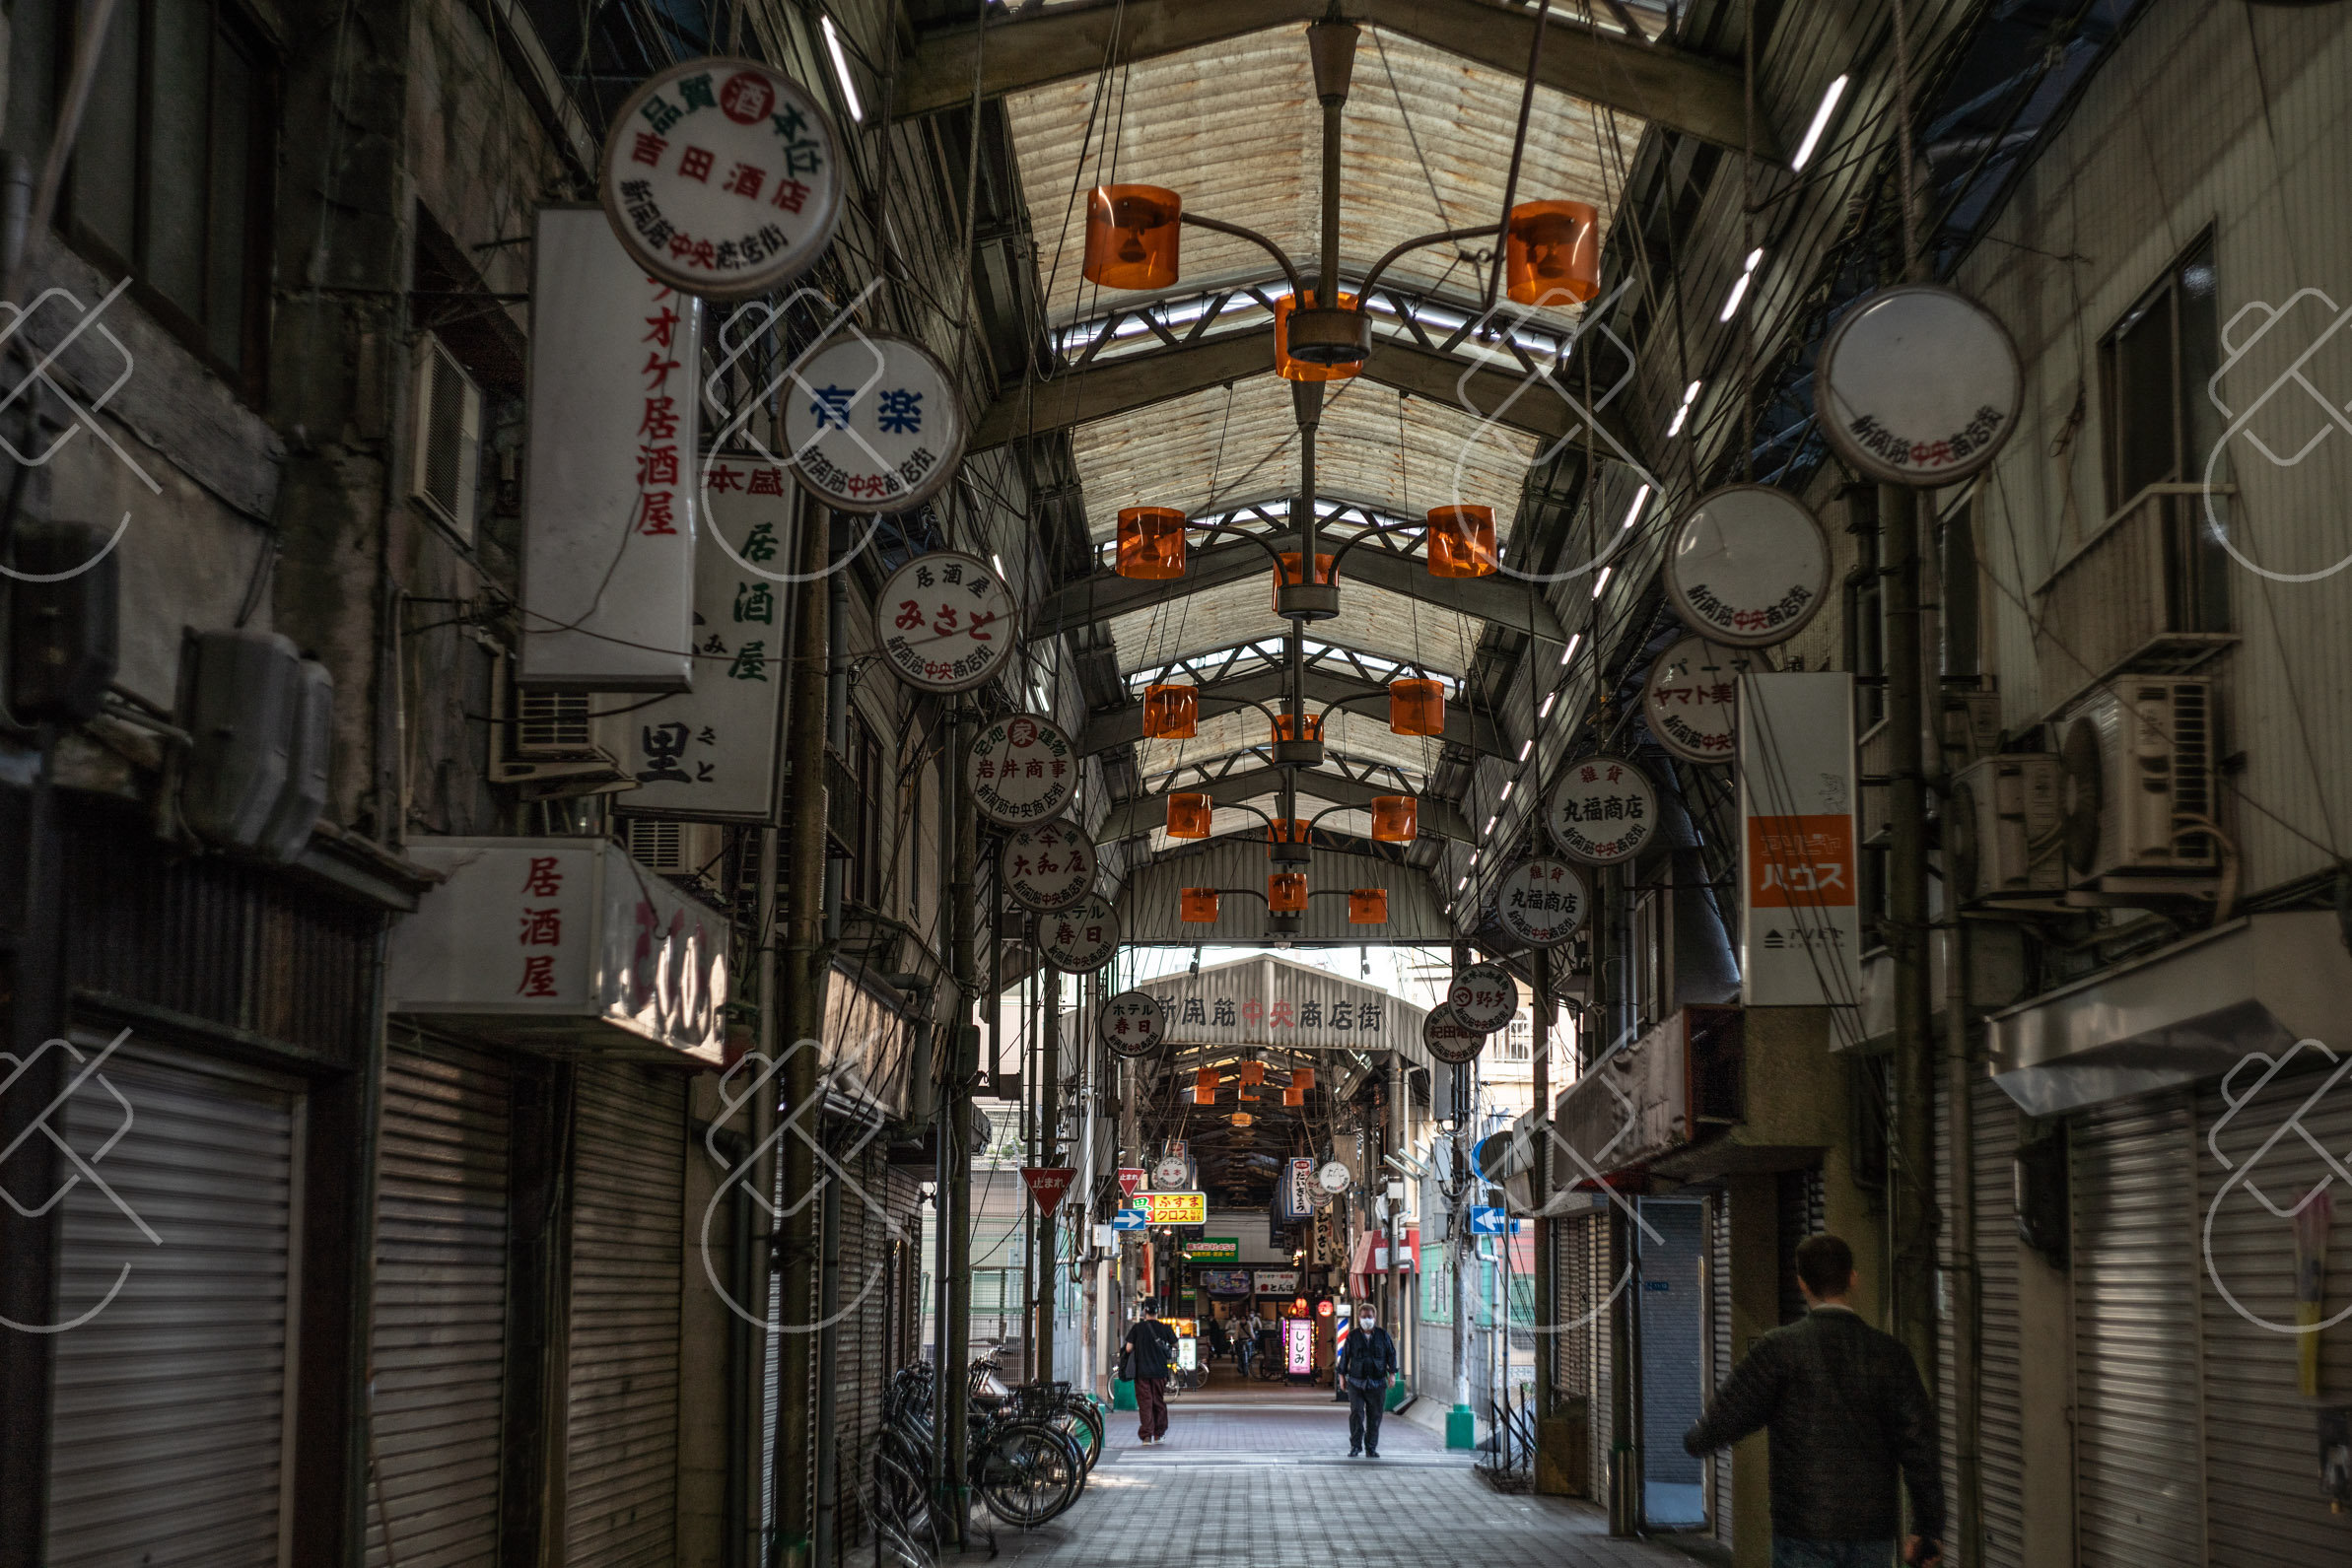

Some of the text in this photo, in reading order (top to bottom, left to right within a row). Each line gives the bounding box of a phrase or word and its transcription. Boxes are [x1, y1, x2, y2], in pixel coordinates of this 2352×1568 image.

[723, 73, 773, 122] 酒
[632, 131, 811, 215] 吉田酒店
[809, 383, 923, 434] 有楽
[916, 562, 991, 599] 居酒屋
[727, 521, 779, 683] 居酒屋
[895, 599, 996, 641] みさと
[976, 758, 1068, 779] 岩井商事
[1563, 793, 1645, 823] 丸福商店
[1760, 862, 1845, 891] ハウス
[1510, 887, 1577, 915] 丸福商店
[516, 855, 565, 998] 居酒屋
[1113, 1003, 1153, 1016] ホテル
[1114, 1016, 1151, 1035] 春日
[1032, 1177, 1066, 1189] 止まれ
[1157, 1209, 1189, 1220] クロス
[1159, 1196, 1199, 1207] ふすま
